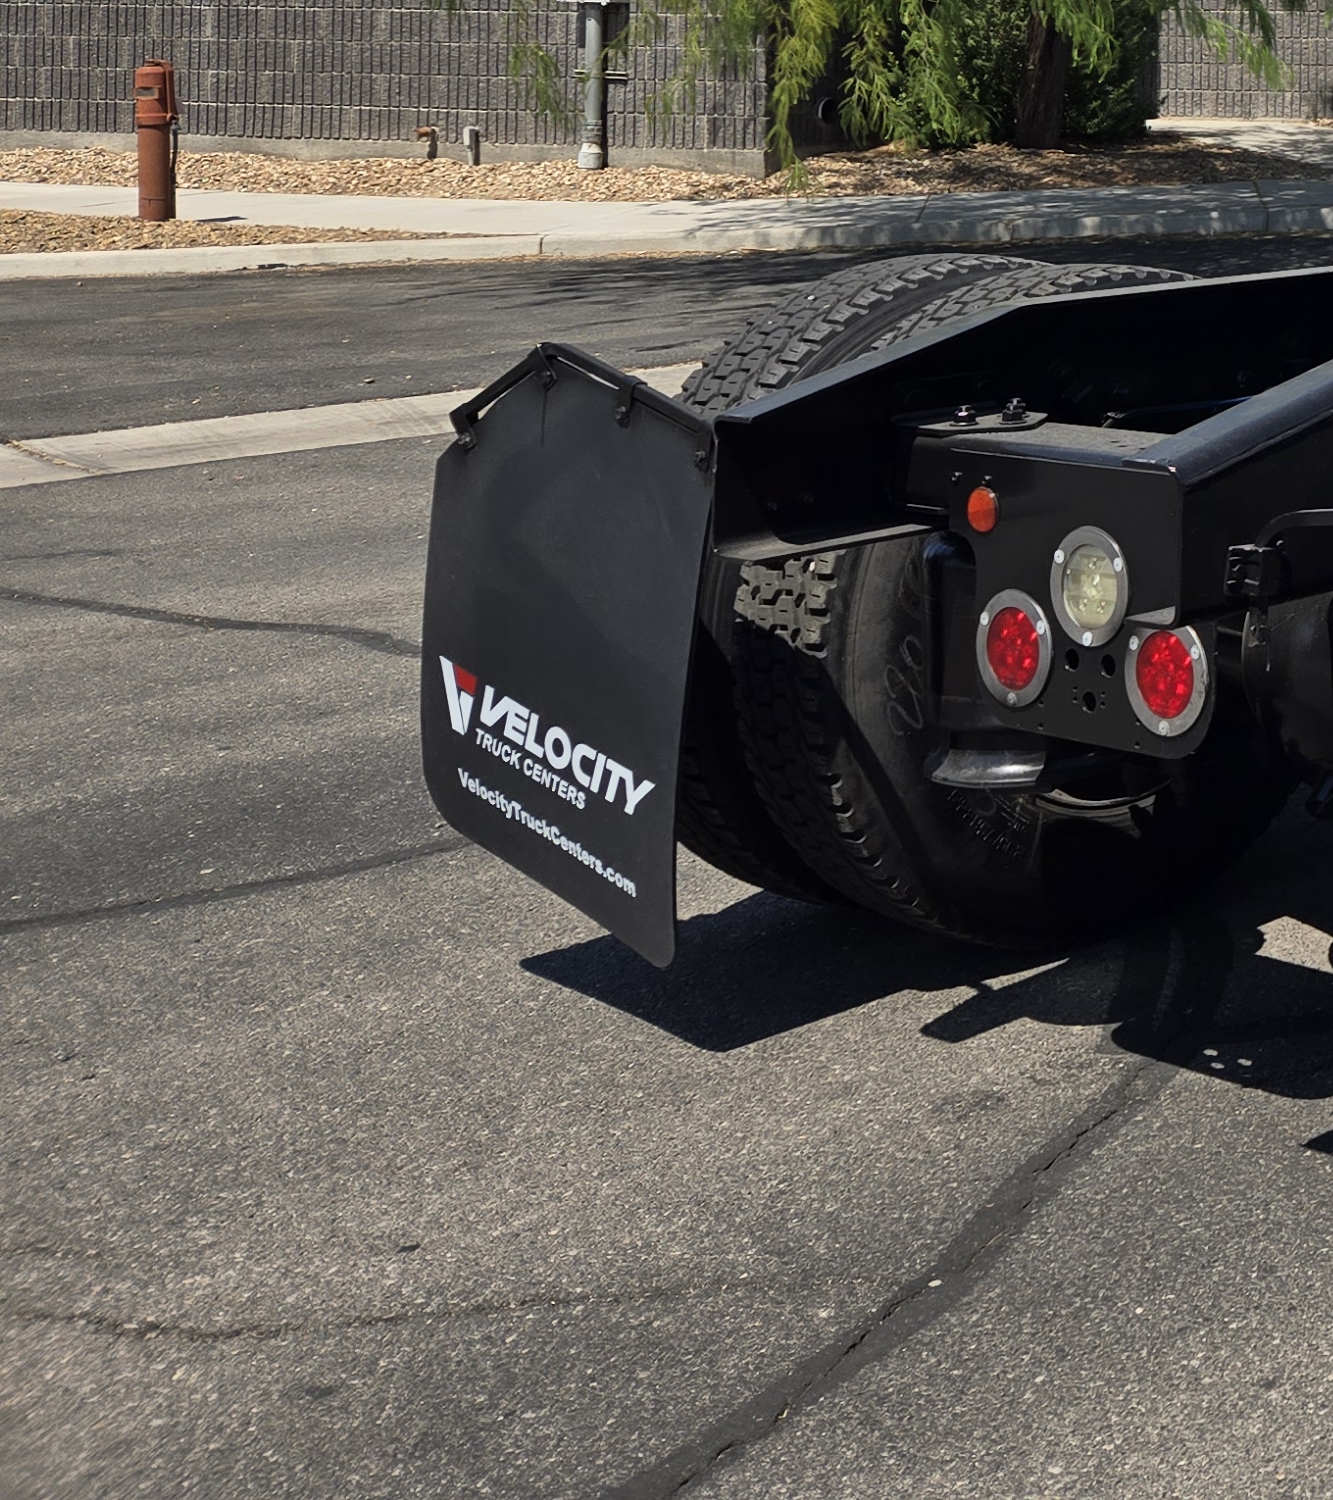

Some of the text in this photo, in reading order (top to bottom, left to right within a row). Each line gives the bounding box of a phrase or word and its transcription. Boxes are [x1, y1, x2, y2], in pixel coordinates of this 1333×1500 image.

[475, 727, 587, 810] TRUCK CENTERS
[479, 684, 656, 816] VELOCITY
[457, 767, 637, 898] VelocityTruckCenters.com
